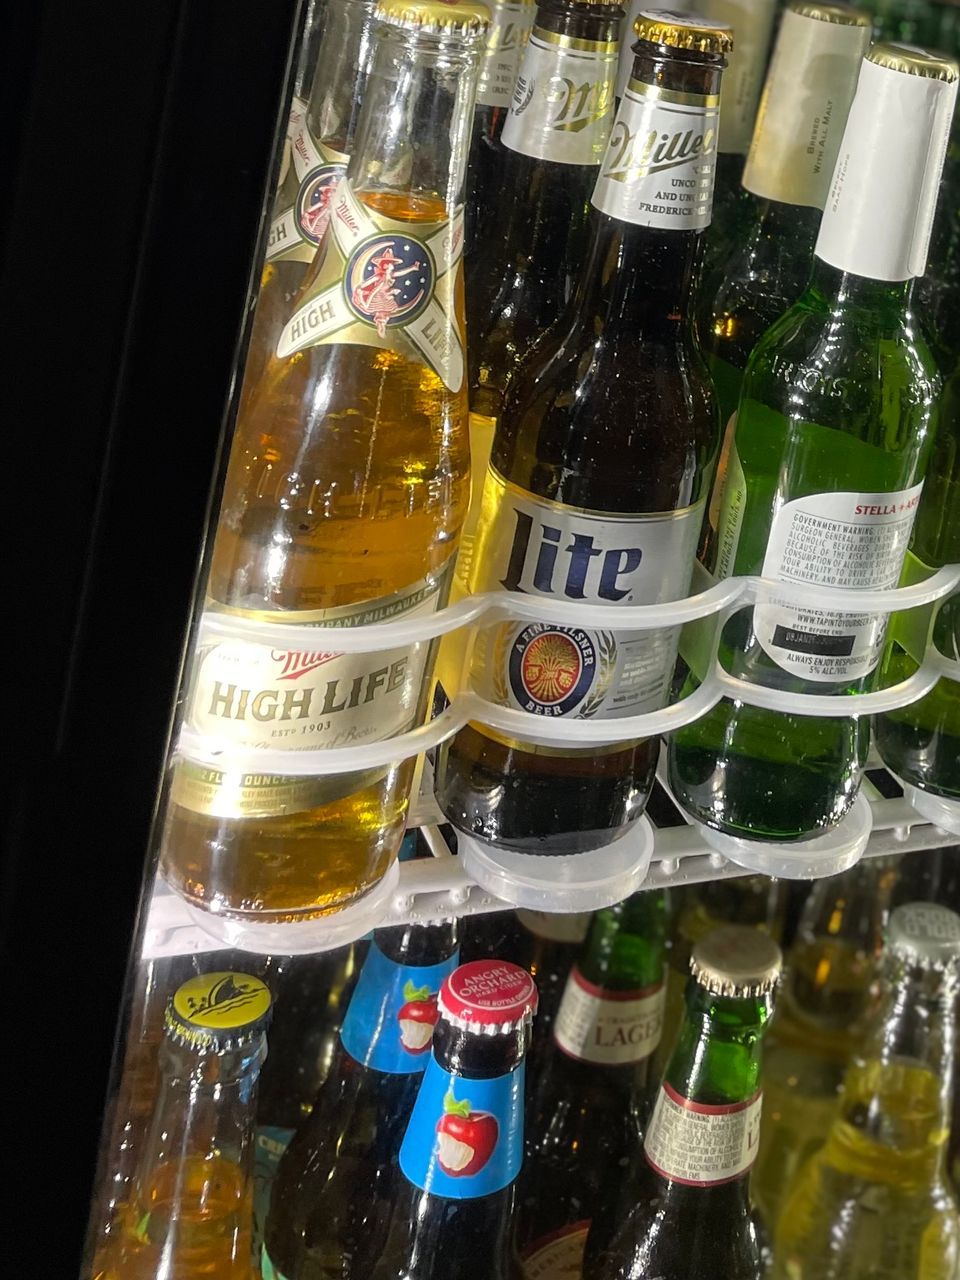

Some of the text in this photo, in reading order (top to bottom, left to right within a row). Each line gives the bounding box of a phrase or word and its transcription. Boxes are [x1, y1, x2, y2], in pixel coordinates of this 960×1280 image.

[654, 191, 677, 201] AND
[335, 195, 361, 236] Miller
[290, 301, 336, 342] HIGH
[854, 504, 896, 516] STELLA
[791, 522, 823, 538] SURGEON
[793, 513, 842, 532] GOVERNMENT
[786, 540, 816, 554] BECAUSE
[820, 547, 830, 556] OF
[833, 550, 845, 559] THE
[848, 552, 863, 560] RISK
[789, 531, 870, 552] ALCOHOLIC BEVERAGES
[783, 556, 801, 568] YOUR
[805, 563, 831, 575] ABILITY
[835, 567, 844, 577] TO
[848, 569, 868, 578] DRIVE
[784, 548, 832, 567] CONSUMPTION
[833, 559, 841, 568] OF
[822, 574, 836, 585] AND
[837, 576, 851, 586] MAY
[516, 623, 595, 667] A FINE PILSNER
[787, 653, 834, 666] ALWAYS ENJOY
[809, 666, 820, 675] 5%
[207, 657, 409, 722] HIGH LIFE
[526, 701, 563, 716] BEER
[301, 720, 332, 735] 1903
[460, 971, 526, 997] ORCHARD
[464, 966, 509, 987] ANGRY
